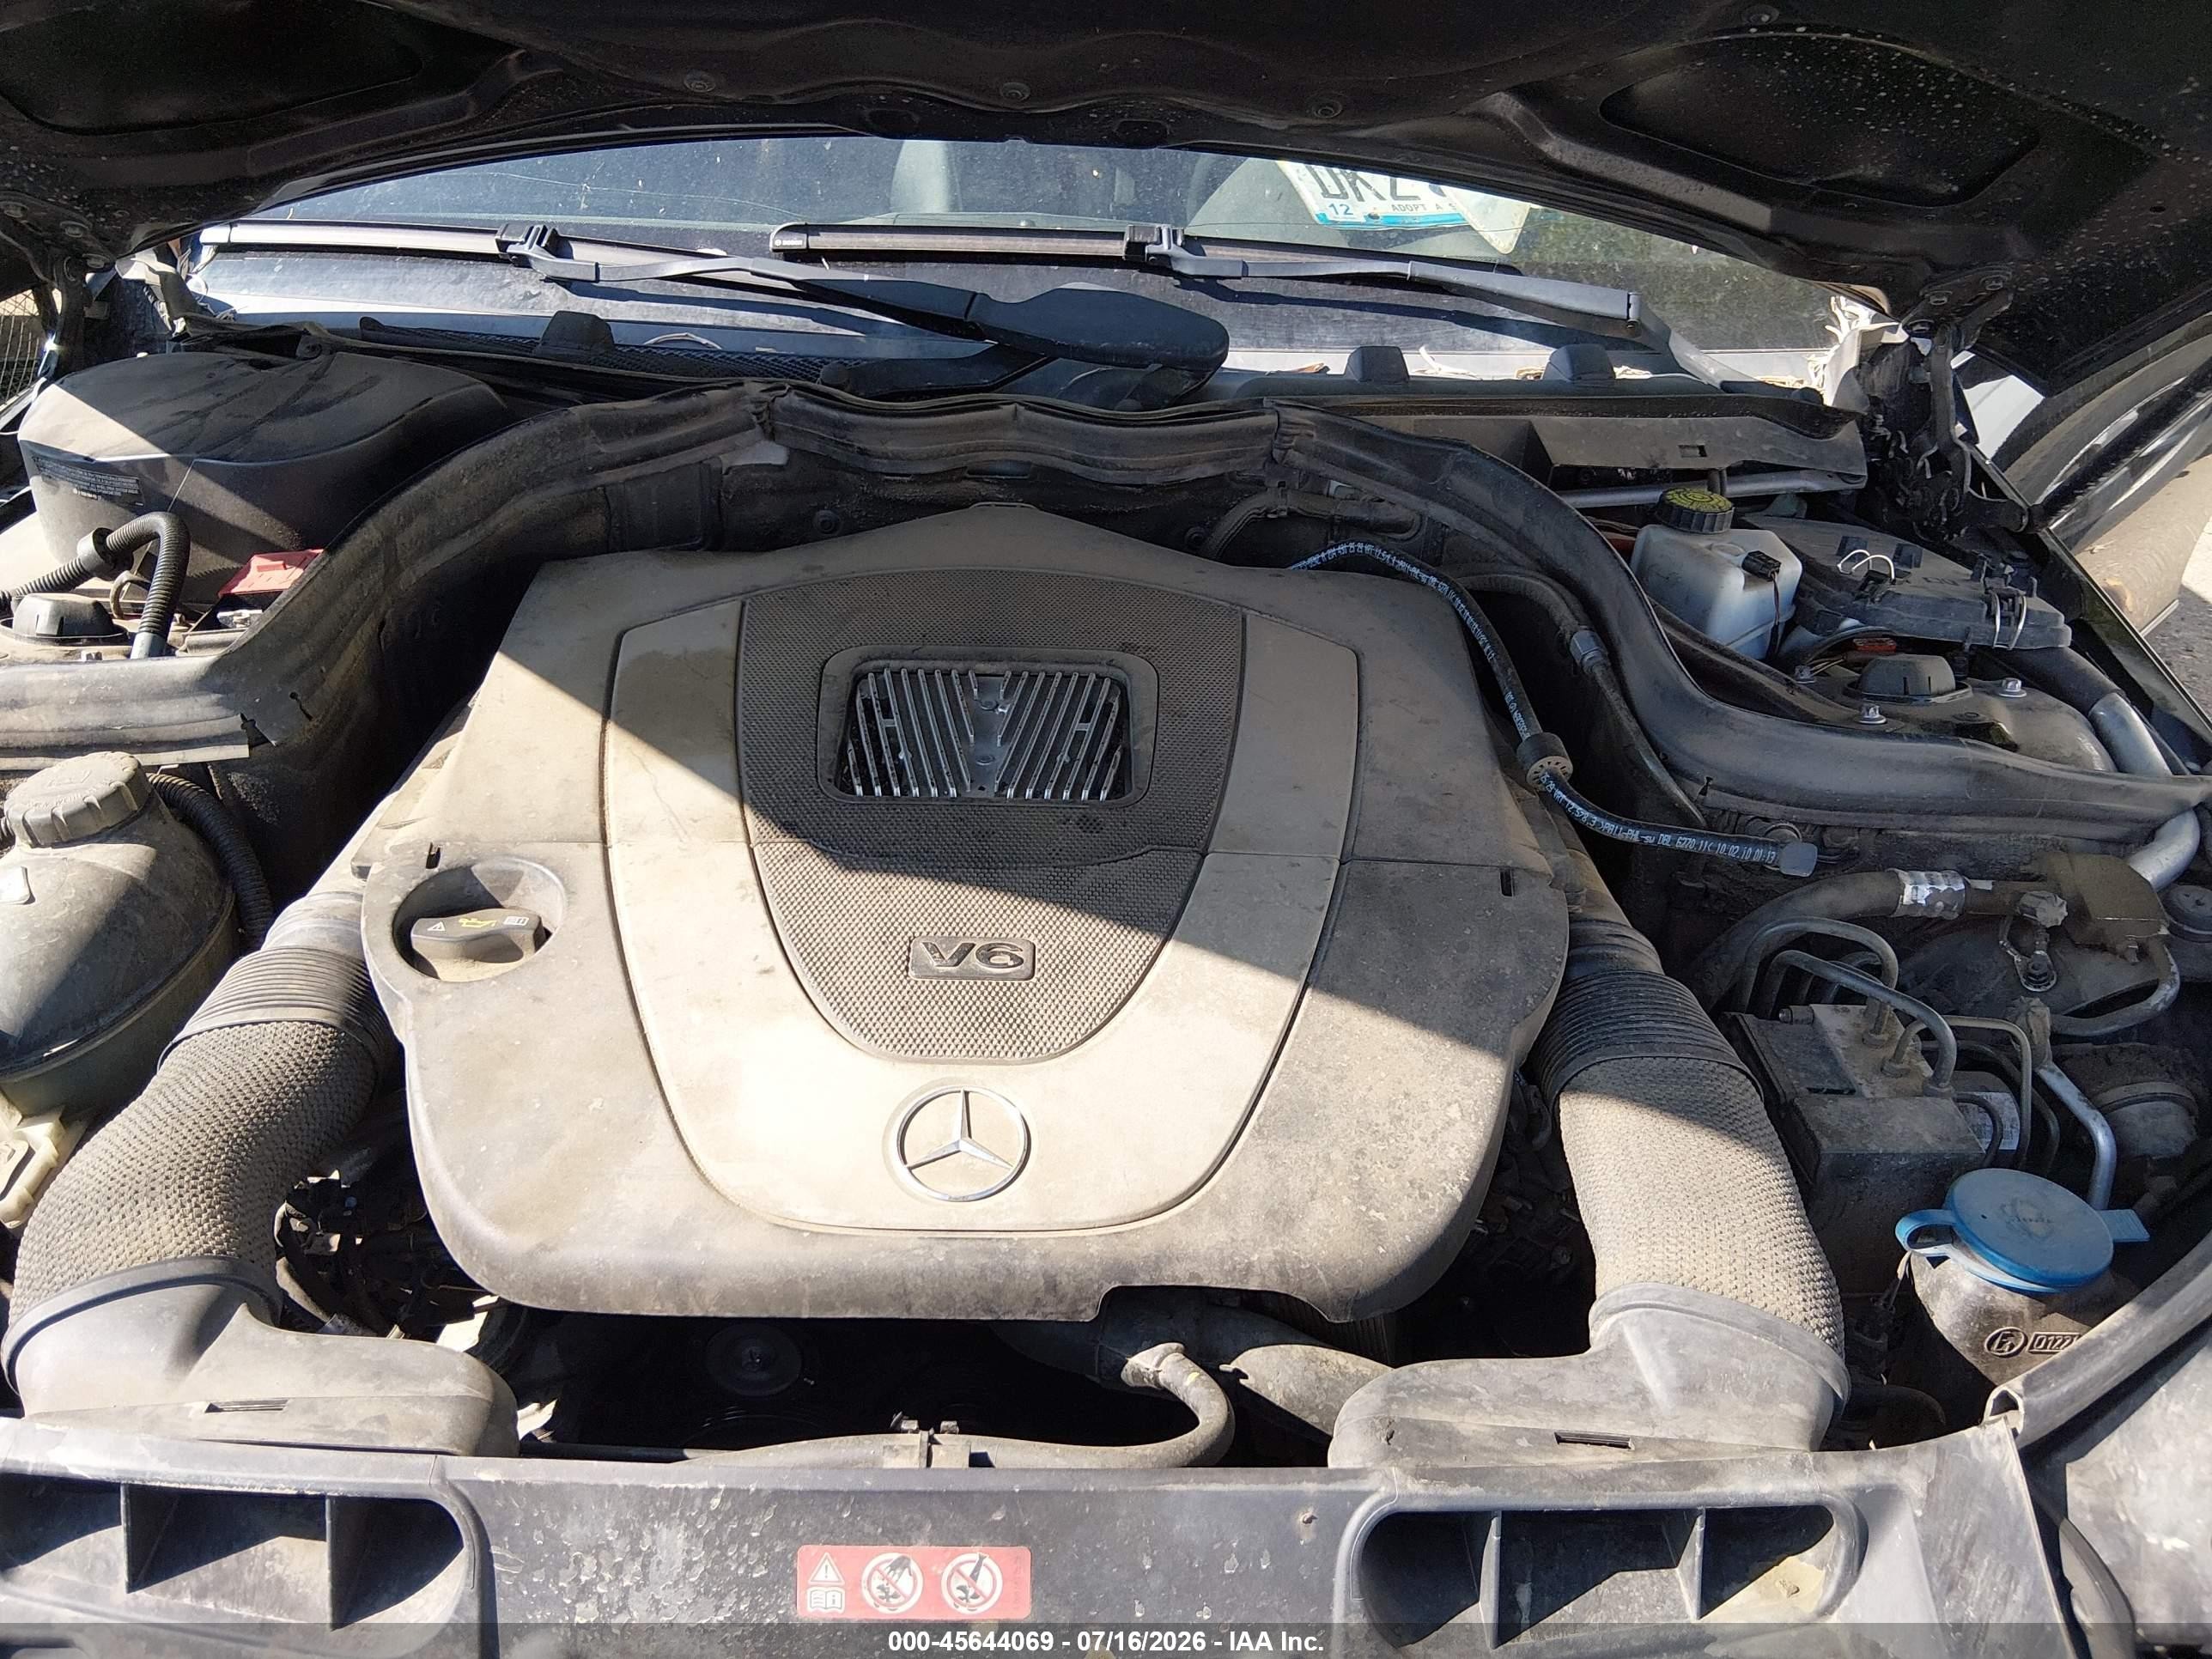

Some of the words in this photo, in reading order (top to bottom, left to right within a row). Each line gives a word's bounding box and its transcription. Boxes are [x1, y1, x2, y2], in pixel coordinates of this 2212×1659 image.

[1328, 203, 1354, 216] 12
[1390, 204, 1427, 212] ADOPT
[1657, 833, 1673, 847] DBL
[921, 942, 1024, 969] V6
[2033, 1334, 2080, 1350] 0122
